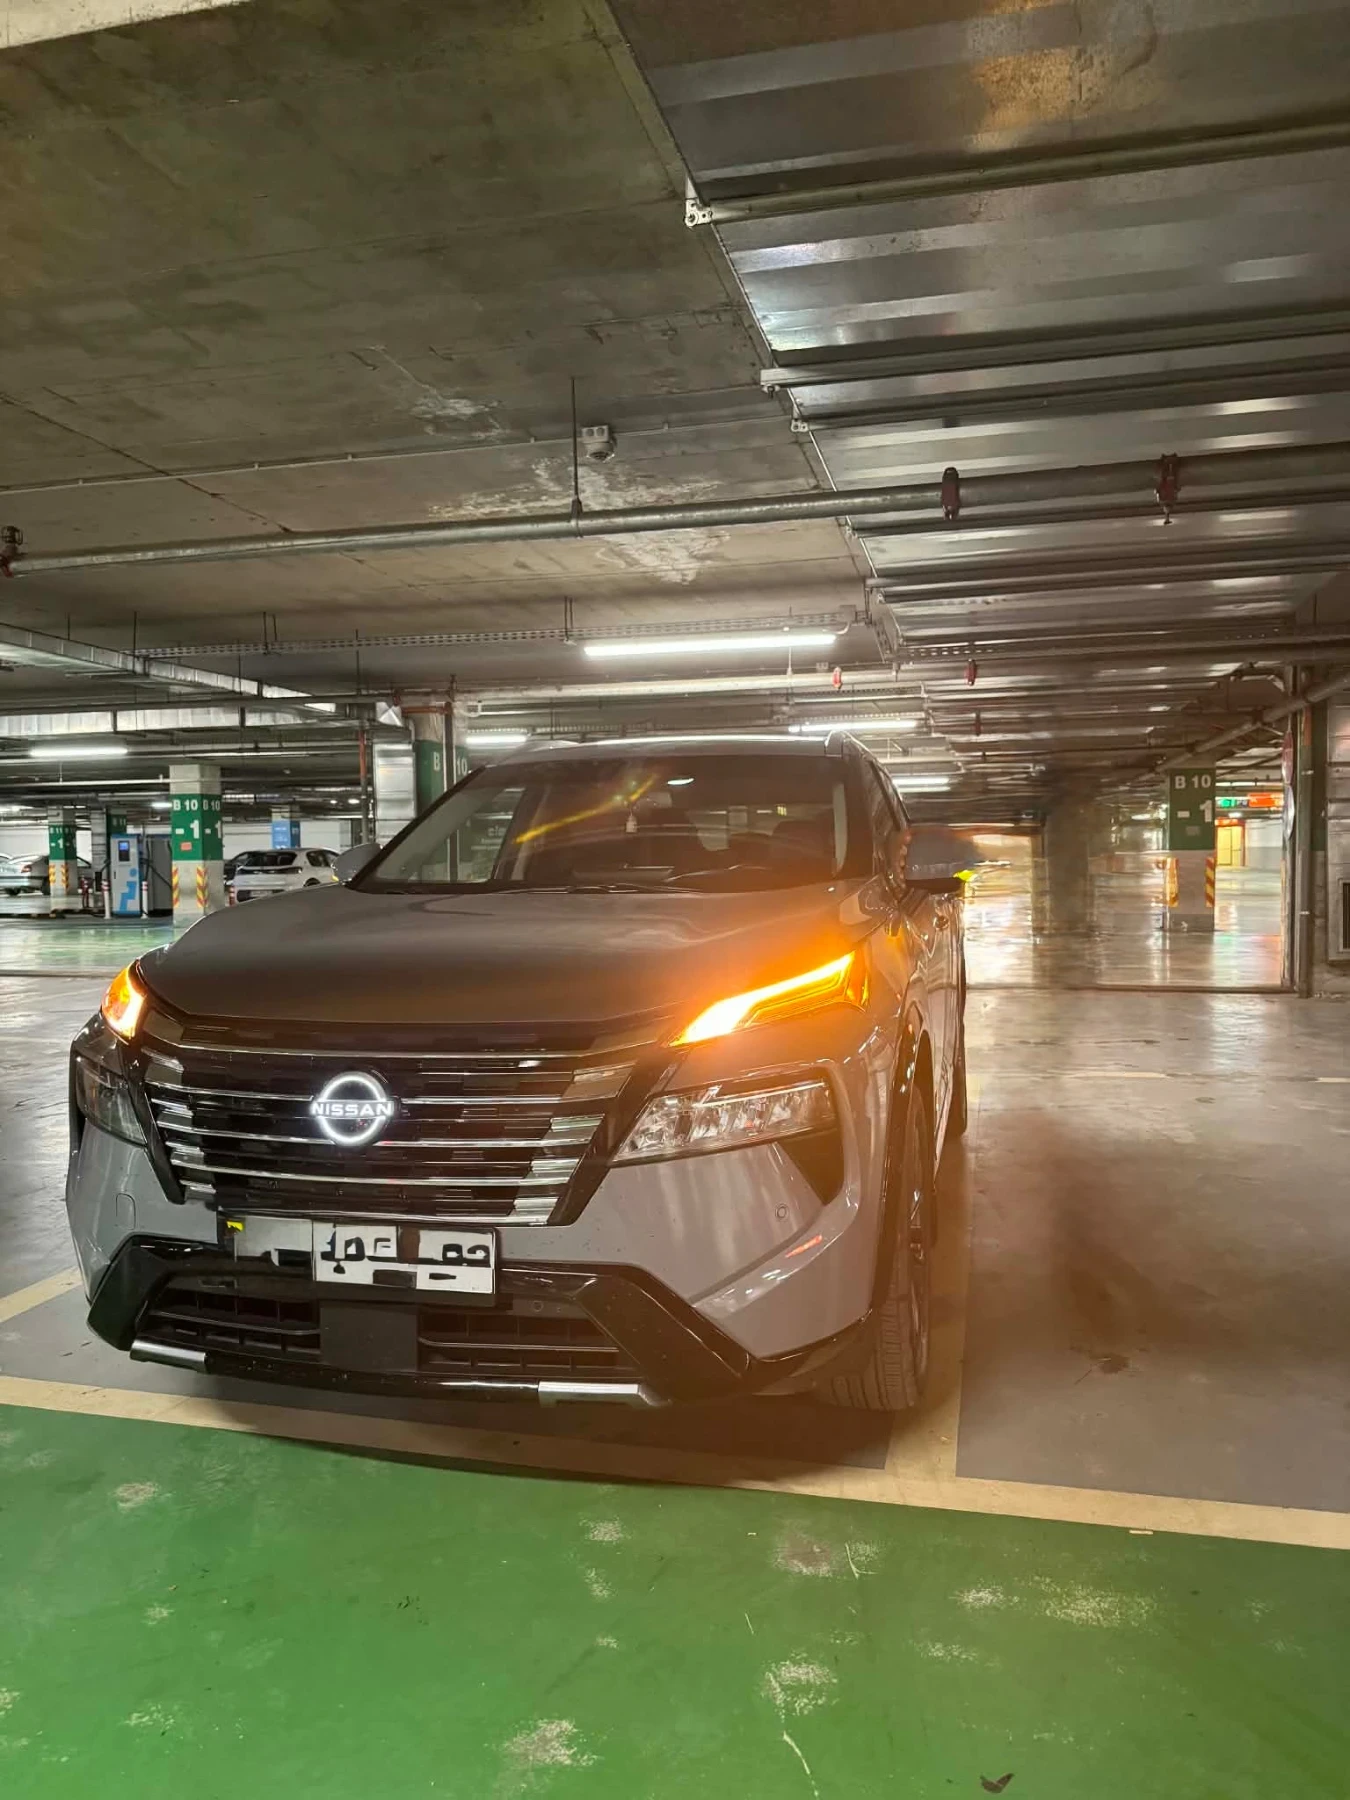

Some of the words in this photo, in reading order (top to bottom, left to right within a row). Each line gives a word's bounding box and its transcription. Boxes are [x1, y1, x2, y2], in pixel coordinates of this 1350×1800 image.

[433, 752, 441, 771] B
[456, 756, 467, 775] 10
[1174, 775, 1186, 789] B
[1191, 774, 1212, 788] 10
[173, 799, 181, 811] B
[184, 799, 198, 811] 10
[211, 799, 221, 811] 10
[311, 1102, 392, 1117] NISSAN
